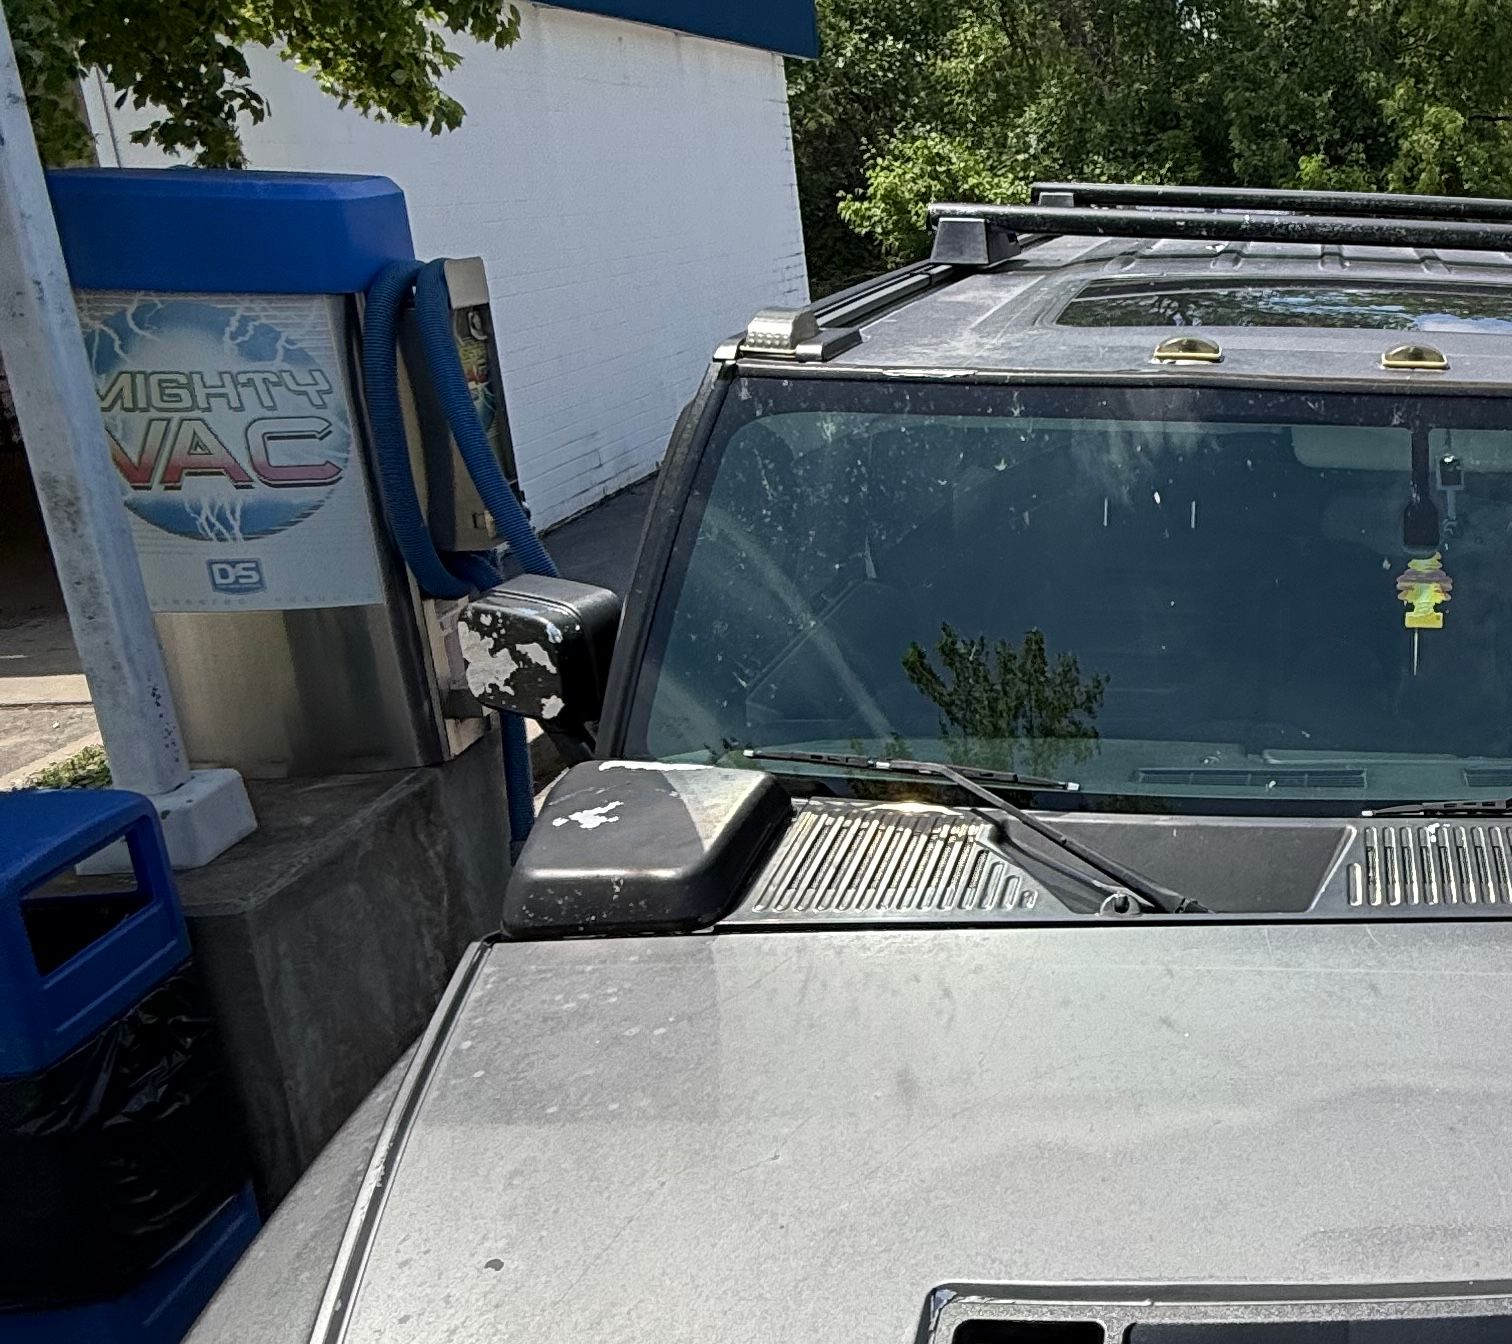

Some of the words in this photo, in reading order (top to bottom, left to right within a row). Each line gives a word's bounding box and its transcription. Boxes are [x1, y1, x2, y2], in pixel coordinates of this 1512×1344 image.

[95, 369, 334, 413] MIGHTY
[104, 415, 344, 491] VAC
[212, 562, 260, 585] DS
